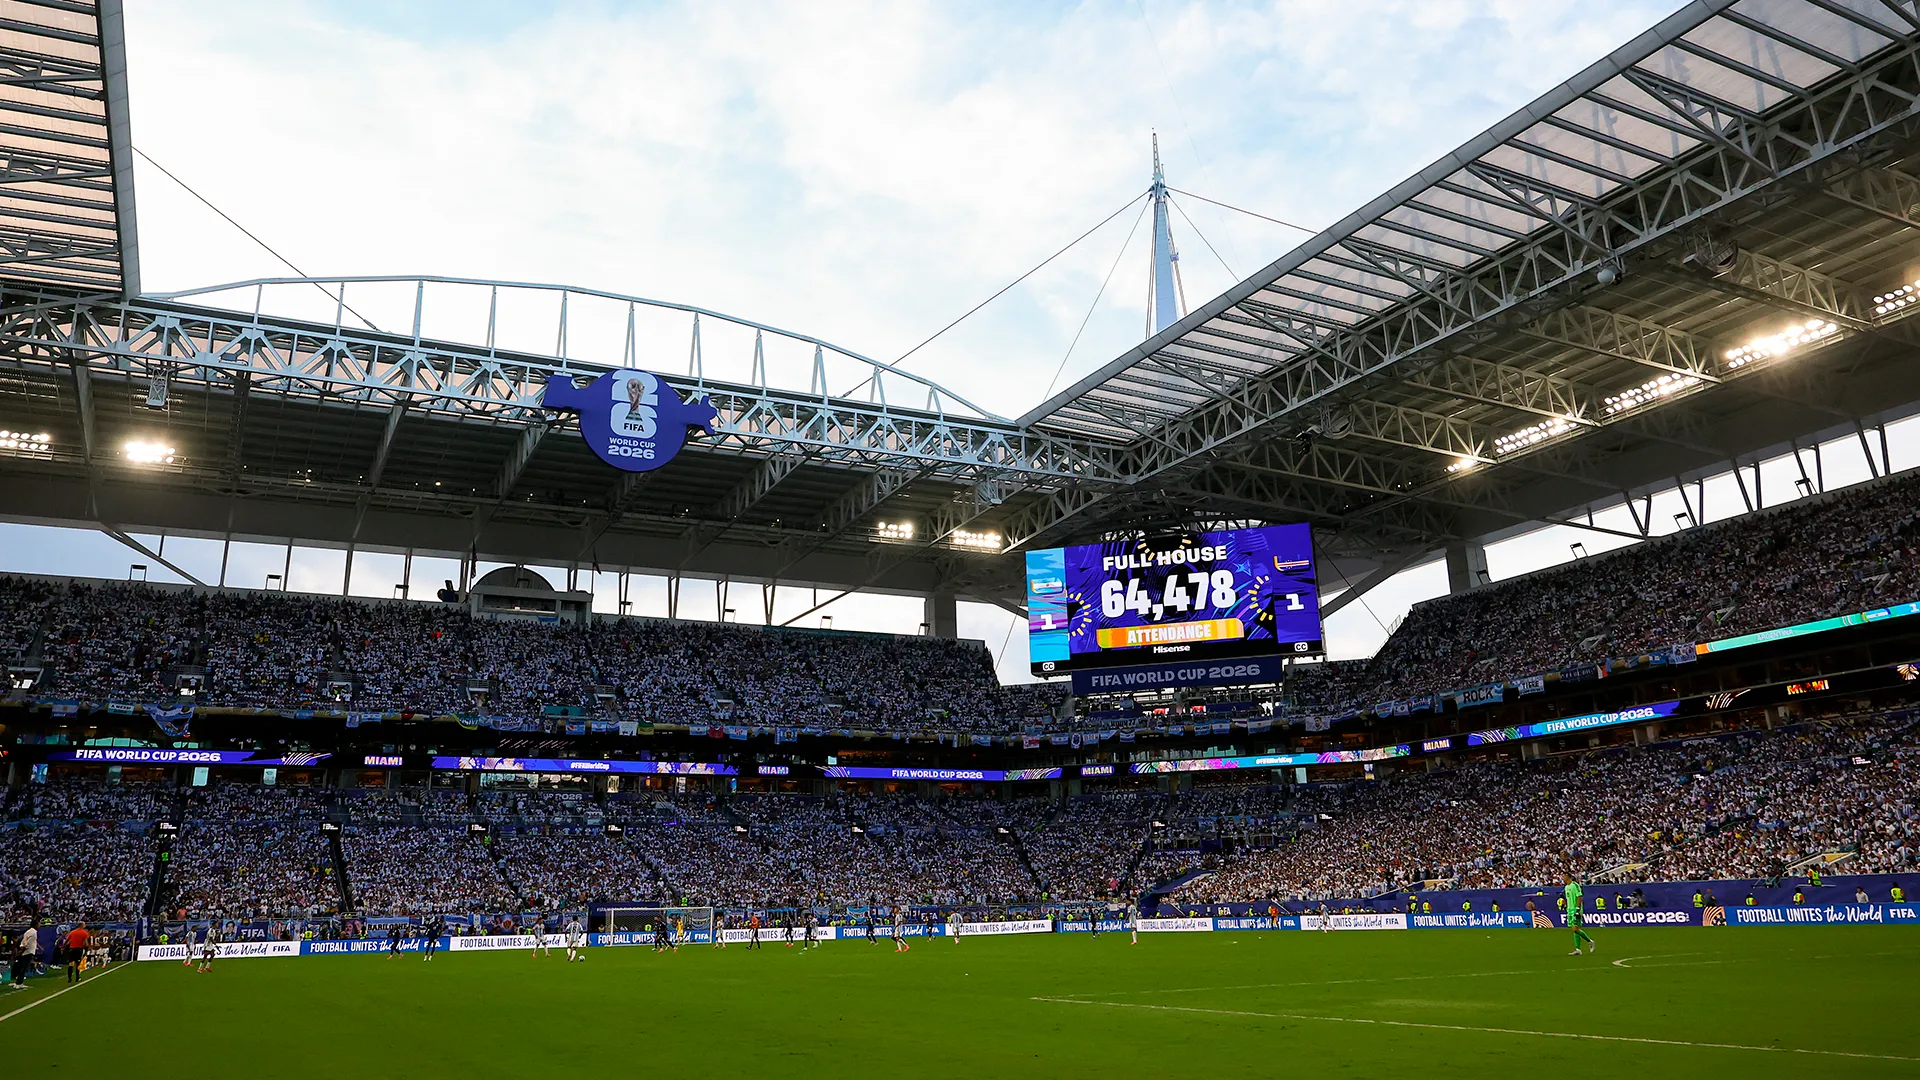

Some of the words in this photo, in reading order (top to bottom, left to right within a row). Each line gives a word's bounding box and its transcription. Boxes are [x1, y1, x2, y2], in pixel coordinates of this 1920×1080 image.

[623, 422, 645, 433] FIFA
[609, 437, 639, 448] WORLD
[639, 440, 656, 449] CUP
[607, 445, 656, 460] 2026
[1102, 551, 1153, 572] FULL
[1156, 545, 1229, 567] HOUSE
[1101, 569, 1237, 622] 64,478
[1285, 593, 1305, 612] 1
[1040, 613, 1058, 631] 1
[1127, 625, 1212, 645] ATTENDANCE
[1757, 629, 1794, 641] ARGENTINA
[1153, 644, 1191, 655] Hisense
[1091, 671, 1122, 688] FIFA
[1124, 670, 1175, 684] WORLD
[1177, 667, 1207, 681] CUP
[1208, 664, 1261, 678] 2026
[1787, 680, 1830, 695] MIAMI
[1463, 687, 1494, 704] ROCK
[1547, 721, 1566, 732] FIFA
[1567, 715, 1599, 729] WORLD
[1600, 712, 1619, 724] CUP
[1619, 707, 1655, 721] 2026
[1424, 739, 1450, 751] MIAMI
[75, 749, 102, 759] FIFA
[104, 750, 150, 761] WORLD
[152, 751, 177, 761] CUP
[178, 752, 222, 762] 2026
[364, 755, 403, 766] MIAMI
[758, 765, 789, 776] MIAMI
[892, 769, 909, 778] FIFA
[910, 770, 939, 779] WORLD
[940, 770, 955, 779] CUP
[956, 771, 984, 779] 2026
[1081, 765, 1113, 775] MIAMI
[921, 912, 938, 920] FFA
[1413, 915, 1444, 926] FOOTBALL
[1445, 914, 1467, 926] UNITES
[1468, 913, 1481, 925] the
[1481, 912, 1504, 927] World
[1507, 915, 1524, 924] FIFA
[1583, 913, 1620, 924] WORLD
[1622, 912, 1645, 924] CUP
[1646, 911, 1686, 923] 2026
[1737, 909, 1785, 923] FOOTBALL
[1787, 907, 1822, 922] UNITES
[1823, 907, 1845, 921] the
[1846, 905, 1883, 924] World
[1889, 908, 1916, 919] FIFA
[368, 923, 408, 931] BARILOHE
[979, 923, 999, 932] UNITES
[1000, 922, 1011, 932] the
[1011, 921, 1030, 931] World
[1063, 922, 1087, 931] FOOTBALL
[1217, 919, 1239, 929] FOOTBALL
[1240, 918, 1256, 928] UNITES
[1333, 917, 1351, 927] UNITES
[1353, 916, 1364, 927] the
[1364, 916, 1382, 928] World
[240, 928, 265, 938] FIFA
[904, 925, 923, 936] World
[460, 937, 495, 948] FOOTBALL
[497, 936, 521, 947] UNITES
[523, 935, 535, 946] the
[597, 934, 631, 944] FOOTBALL
[632, 933, 656, 943] UNITES
[694, 932, 709, 940] FIFA
[224, 943, 240, 955] the
[240, 941, 268, 955] World
[310, 941, 349, 953] FOOTBALL
[350, 940, 377, 951] UNITES
[379, 939, 392, 951] the
